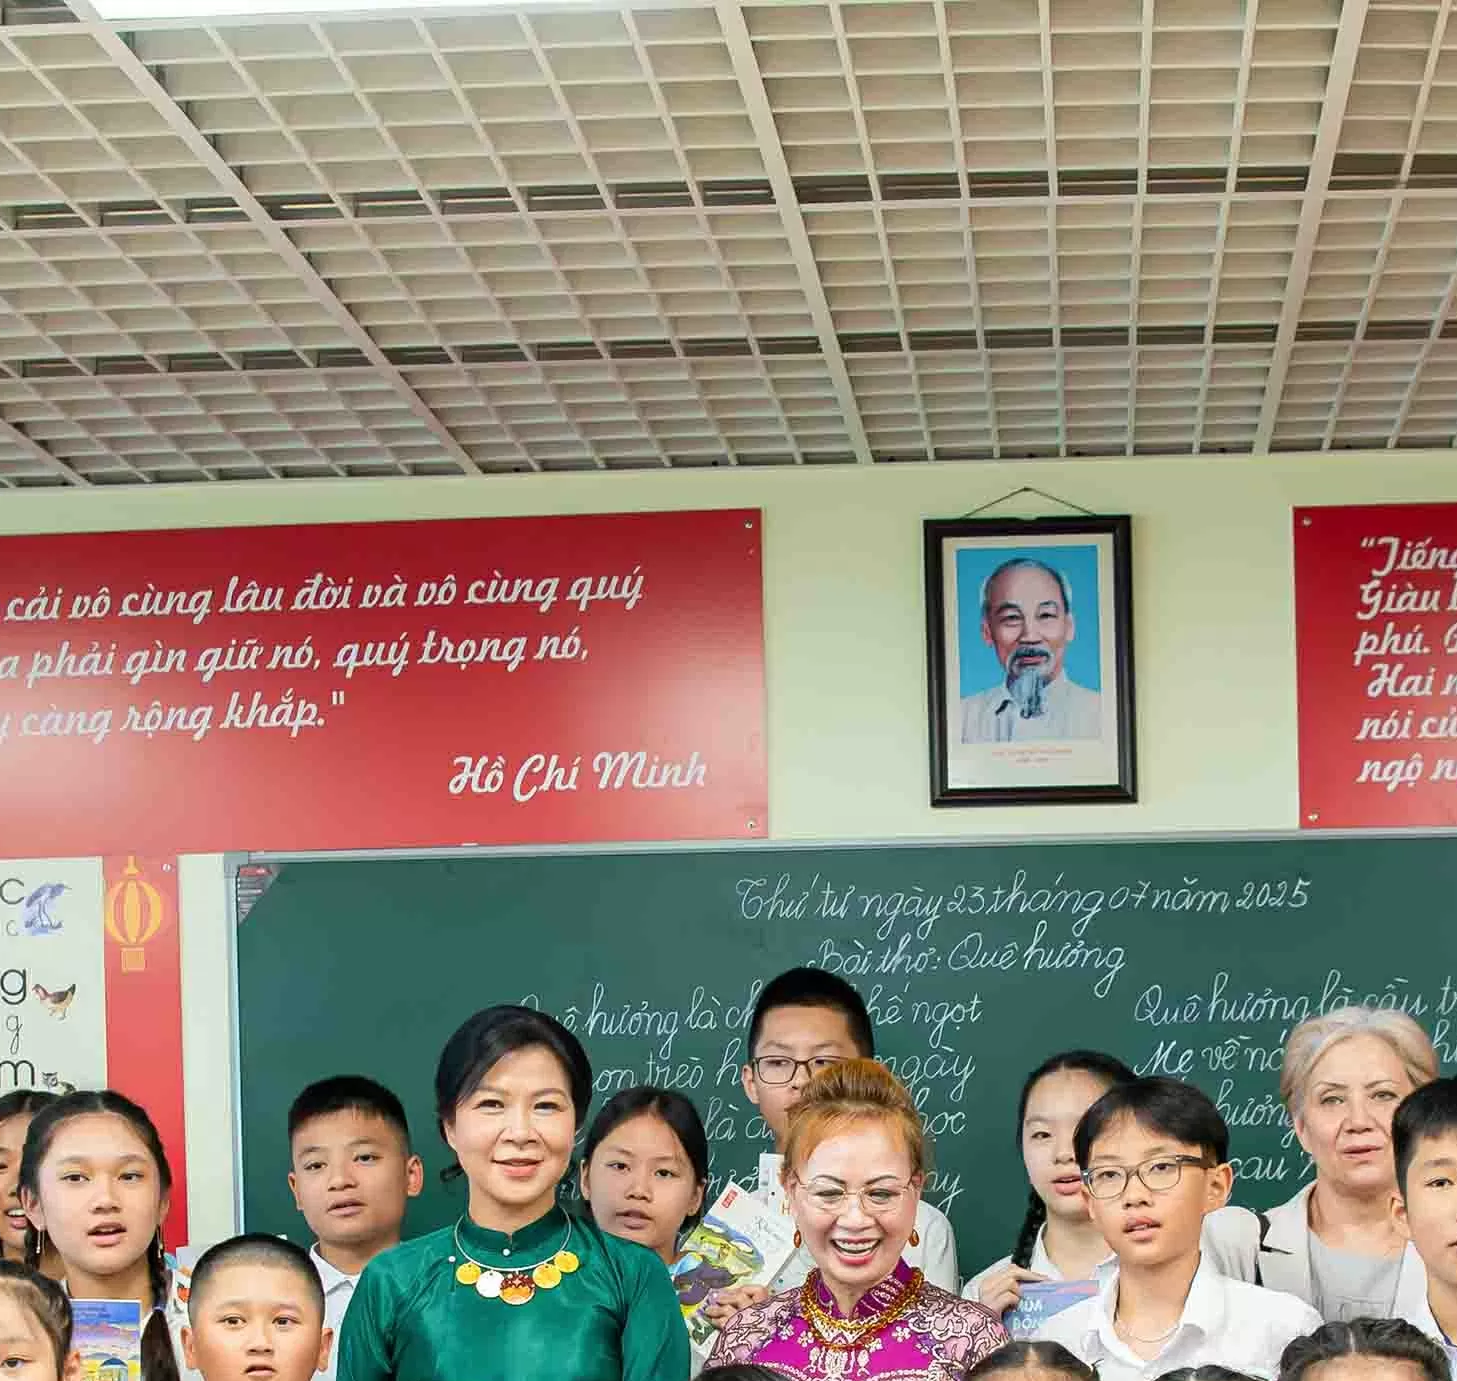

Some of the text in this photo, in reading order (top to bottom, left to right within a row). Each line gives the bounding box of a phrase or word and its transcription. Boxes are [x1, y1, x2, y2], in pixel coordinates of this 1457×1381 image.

[4, 586, 64, 621] cải
[68, 584, 111, 619] vô
[118, 582, 213, 624] cùng
[218, 576, 284, 614] lâu
[290, 571, 352, 611] đời
[358, 574, 408, 608] và
[413, 574, 458, 607] vô
[464, 569, 560, 613] cùng
[565, 565, 644, 612] quý
[1355, 574, 1440, 620] Giàu
[26, 641, 116, 688] phải
[121, 640, 186, 676] gìn
[193, 638, 264, 683] giữ
[265, 635, 320, 670] nó,
[332, 632, 410, 679] quý
[417, 629, 528, 672] trọng
[532, 626, 588, 661] nó,
[20, 703, 113, 745] càng
[120, 700, 214, 741] rộng
[448, 752, 706, 802] Hồ Chí Minh
[0, 878, 24, 904] c
[735, 872, 820, 920] Thứ
[858, 884, 944, 941] ngày
[986, 869, 1104, 936] tháng
[1151, 875, 1231, 913] năm
[1235, 877, 1312, 909] 2025
[808, 919, 1126, 998] Bài thơ: Quê hương
[0, 969, 27, 1005] g
[1134, 984, 1201, 1026] Quê
[586, 984, 984, 1058] hương là ngọt
[1133, 1039, 1195, 1083] Mẹ
[1200, 1031, 1252, 1072] về
[705, 1096, 740, 1142] là
